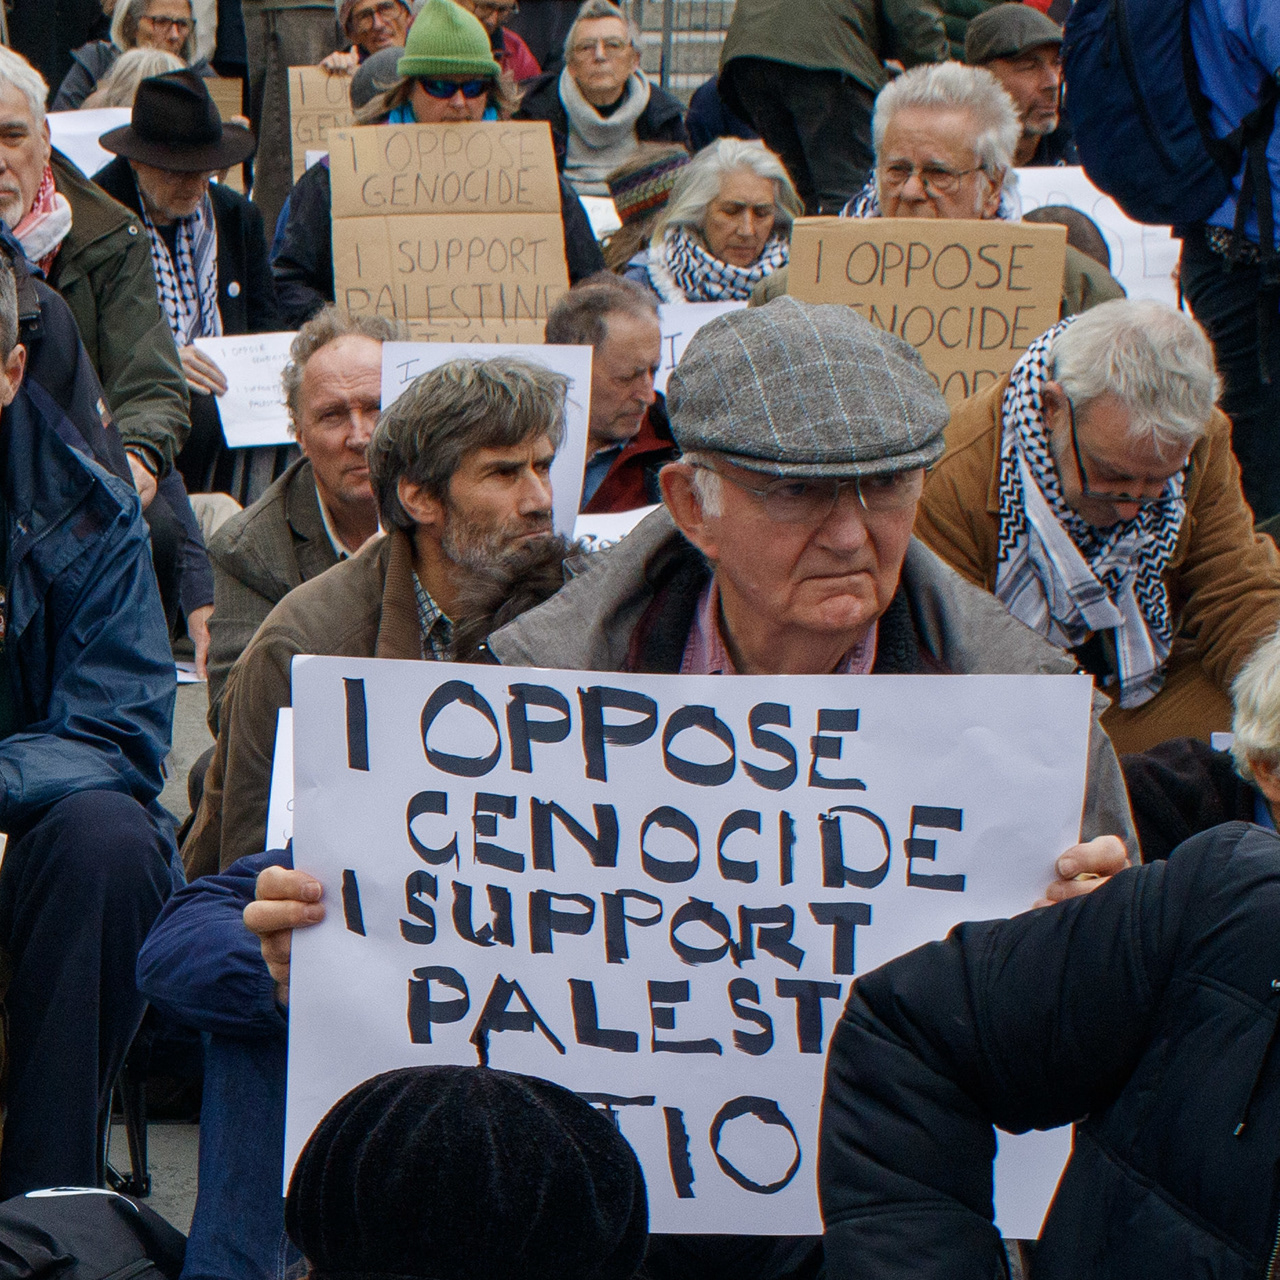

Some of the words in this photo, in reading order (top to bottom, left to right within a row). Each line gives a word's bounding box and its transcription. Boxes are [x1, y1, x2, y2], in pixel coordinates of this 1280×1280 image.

[350, 136, 357, 173] I
[385, 129, 541, 172] OPPOSE
[361, 168, 534, 207] GENOCIDE
[356, 243, 361, 278] I
[397, 237, 548, 275] SUPPORT
[814, 240, 823, 284] I
[845, 240, 1035, 292] OPPOSE
[342, 677, 370, 772] I
[419, 679, 868, 792] OPPOSE
[406, 790, 966, 893] GENOCIDE
[342, 869, 367, 937] I
[399, 870, 873, 976] SUPPORT
[406, 965, 842, 1067] PALEST
